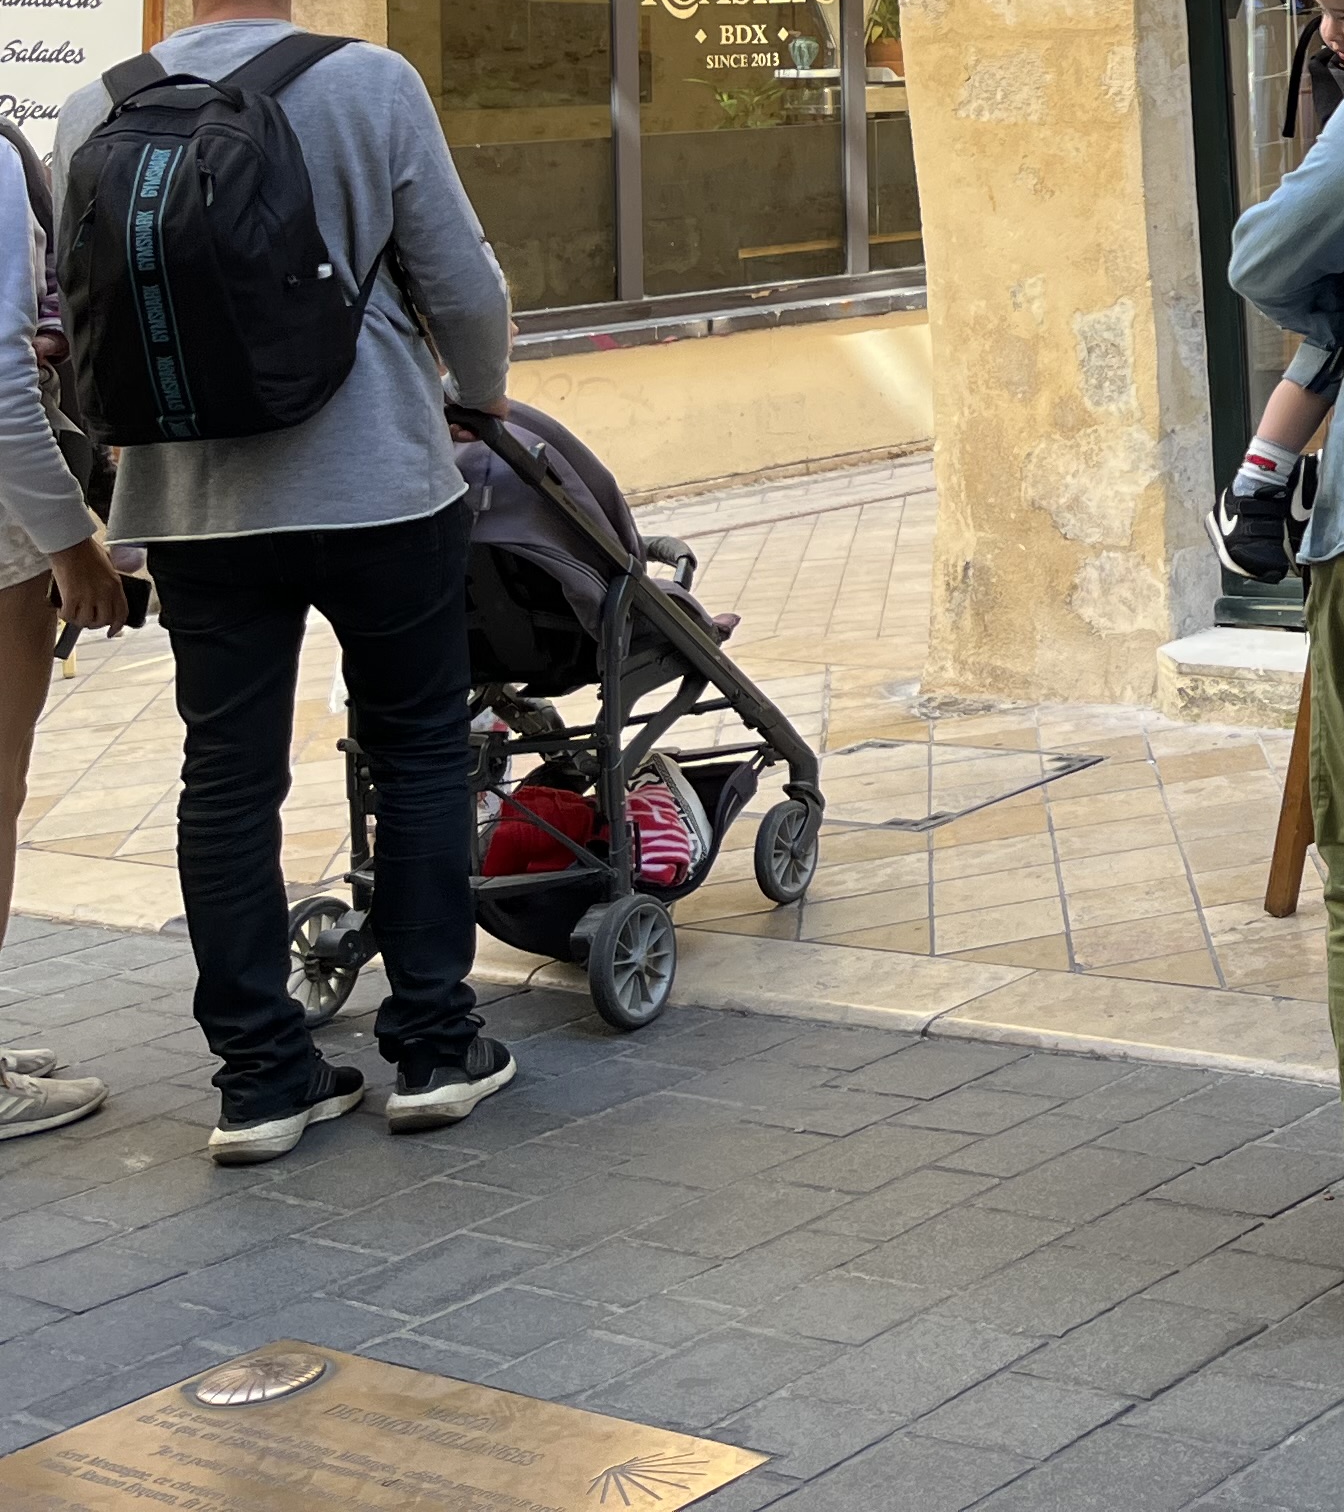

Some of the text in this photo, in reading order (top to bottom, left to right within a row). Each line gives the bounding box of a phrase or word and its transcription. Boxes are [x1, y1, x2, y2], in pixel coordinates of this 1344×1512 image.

[719, 24, 768, 45] BDX
[1, 39, 86, 65] Salades
[706, 52, 780, 69] SINCE 2013
[0, 94, 60, 126] Déjeu
[140, 148, 172, 198] GYMSHARK
[135, 210, 156, 271] GYMSHARK
[355, 1411, 428, 1436] SIMON
